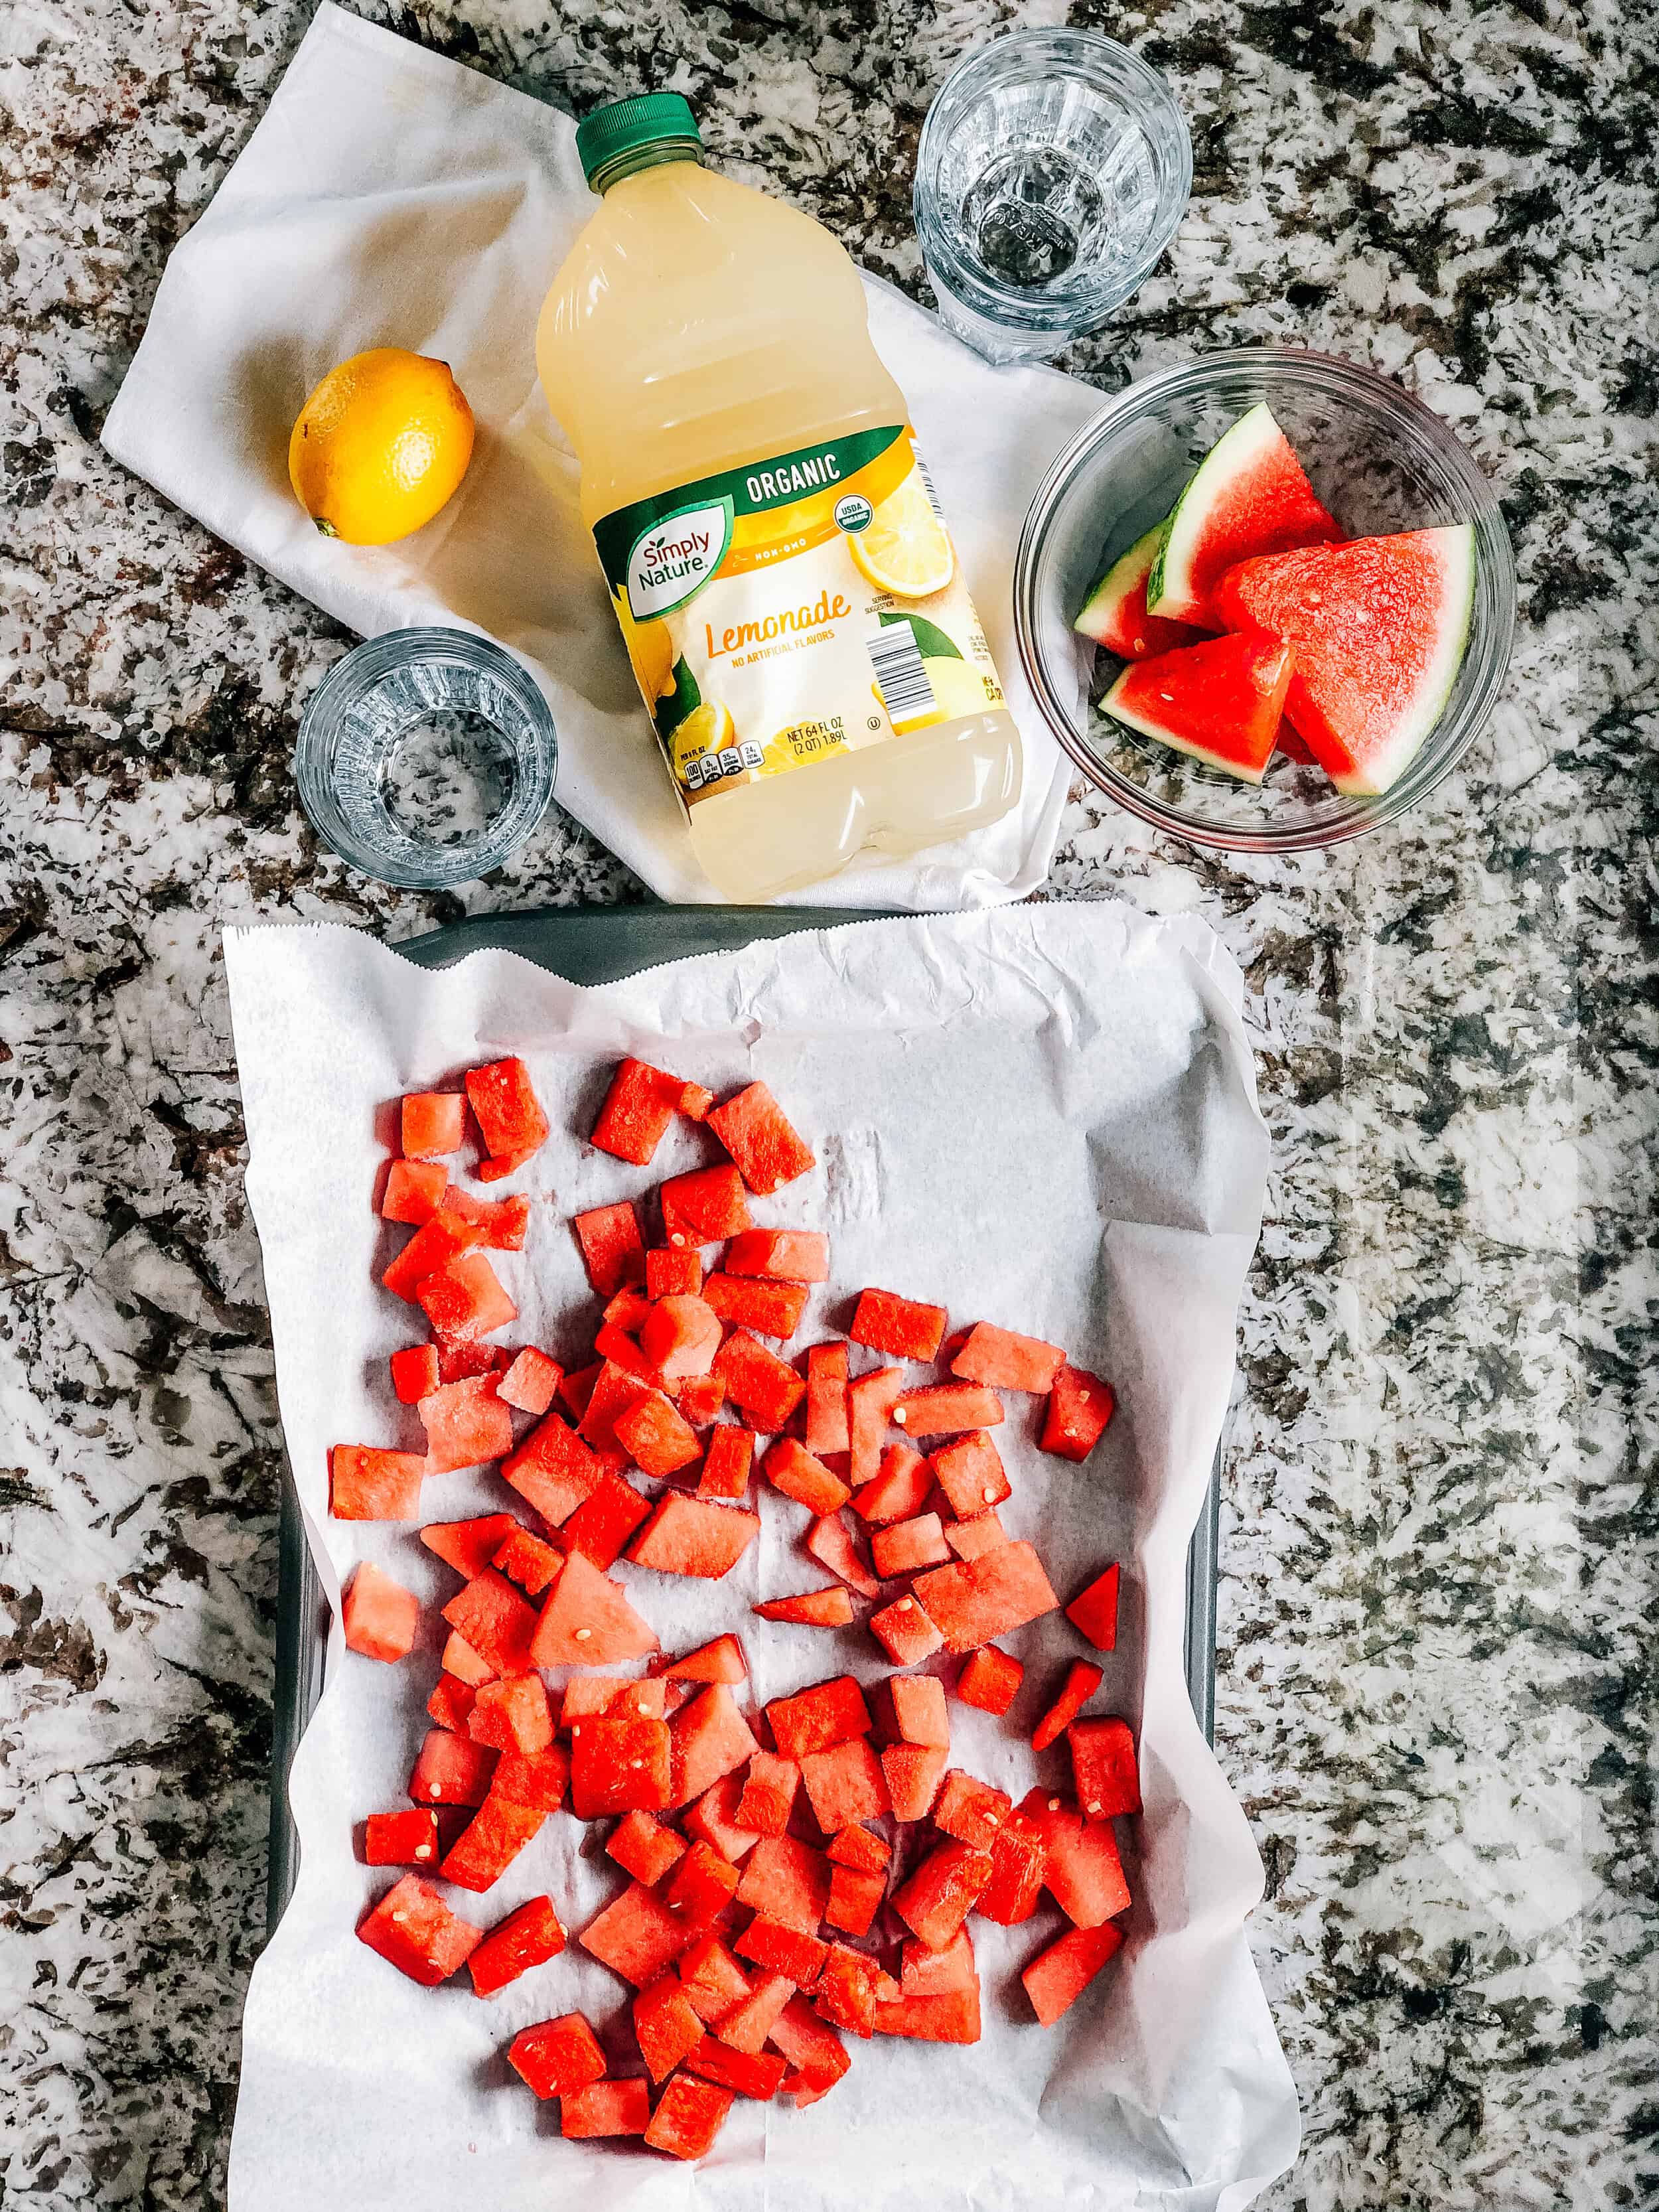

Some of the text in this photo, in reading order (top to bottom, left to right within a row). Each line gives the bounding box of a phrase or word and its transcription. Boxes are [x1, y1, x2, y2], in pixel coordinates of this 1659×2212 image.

[747, 453, 840, 502] ORGANIC
[841, 503, 862, 515] USDA
[842, 512, 869, 526] ORGANIC
[644, 532, 709, 567] Simply
[755, 538, 807, 561] NON-GMO
[638, 557, 704, 591] Nature
[865, 599, 894, 614] SUGGESTION
[872, 593, 893, 604] SERVING
[705, 589, 851, 659] Lemonade
[731, 628, 835, 668] NO ARTIFICIAL FLAVORS
[786, 716, 845, 743] NET 64 FL OZ
[794, 729, 847, 756] (2 QT) 1.89L
[686, 764, 698, 777] 100
